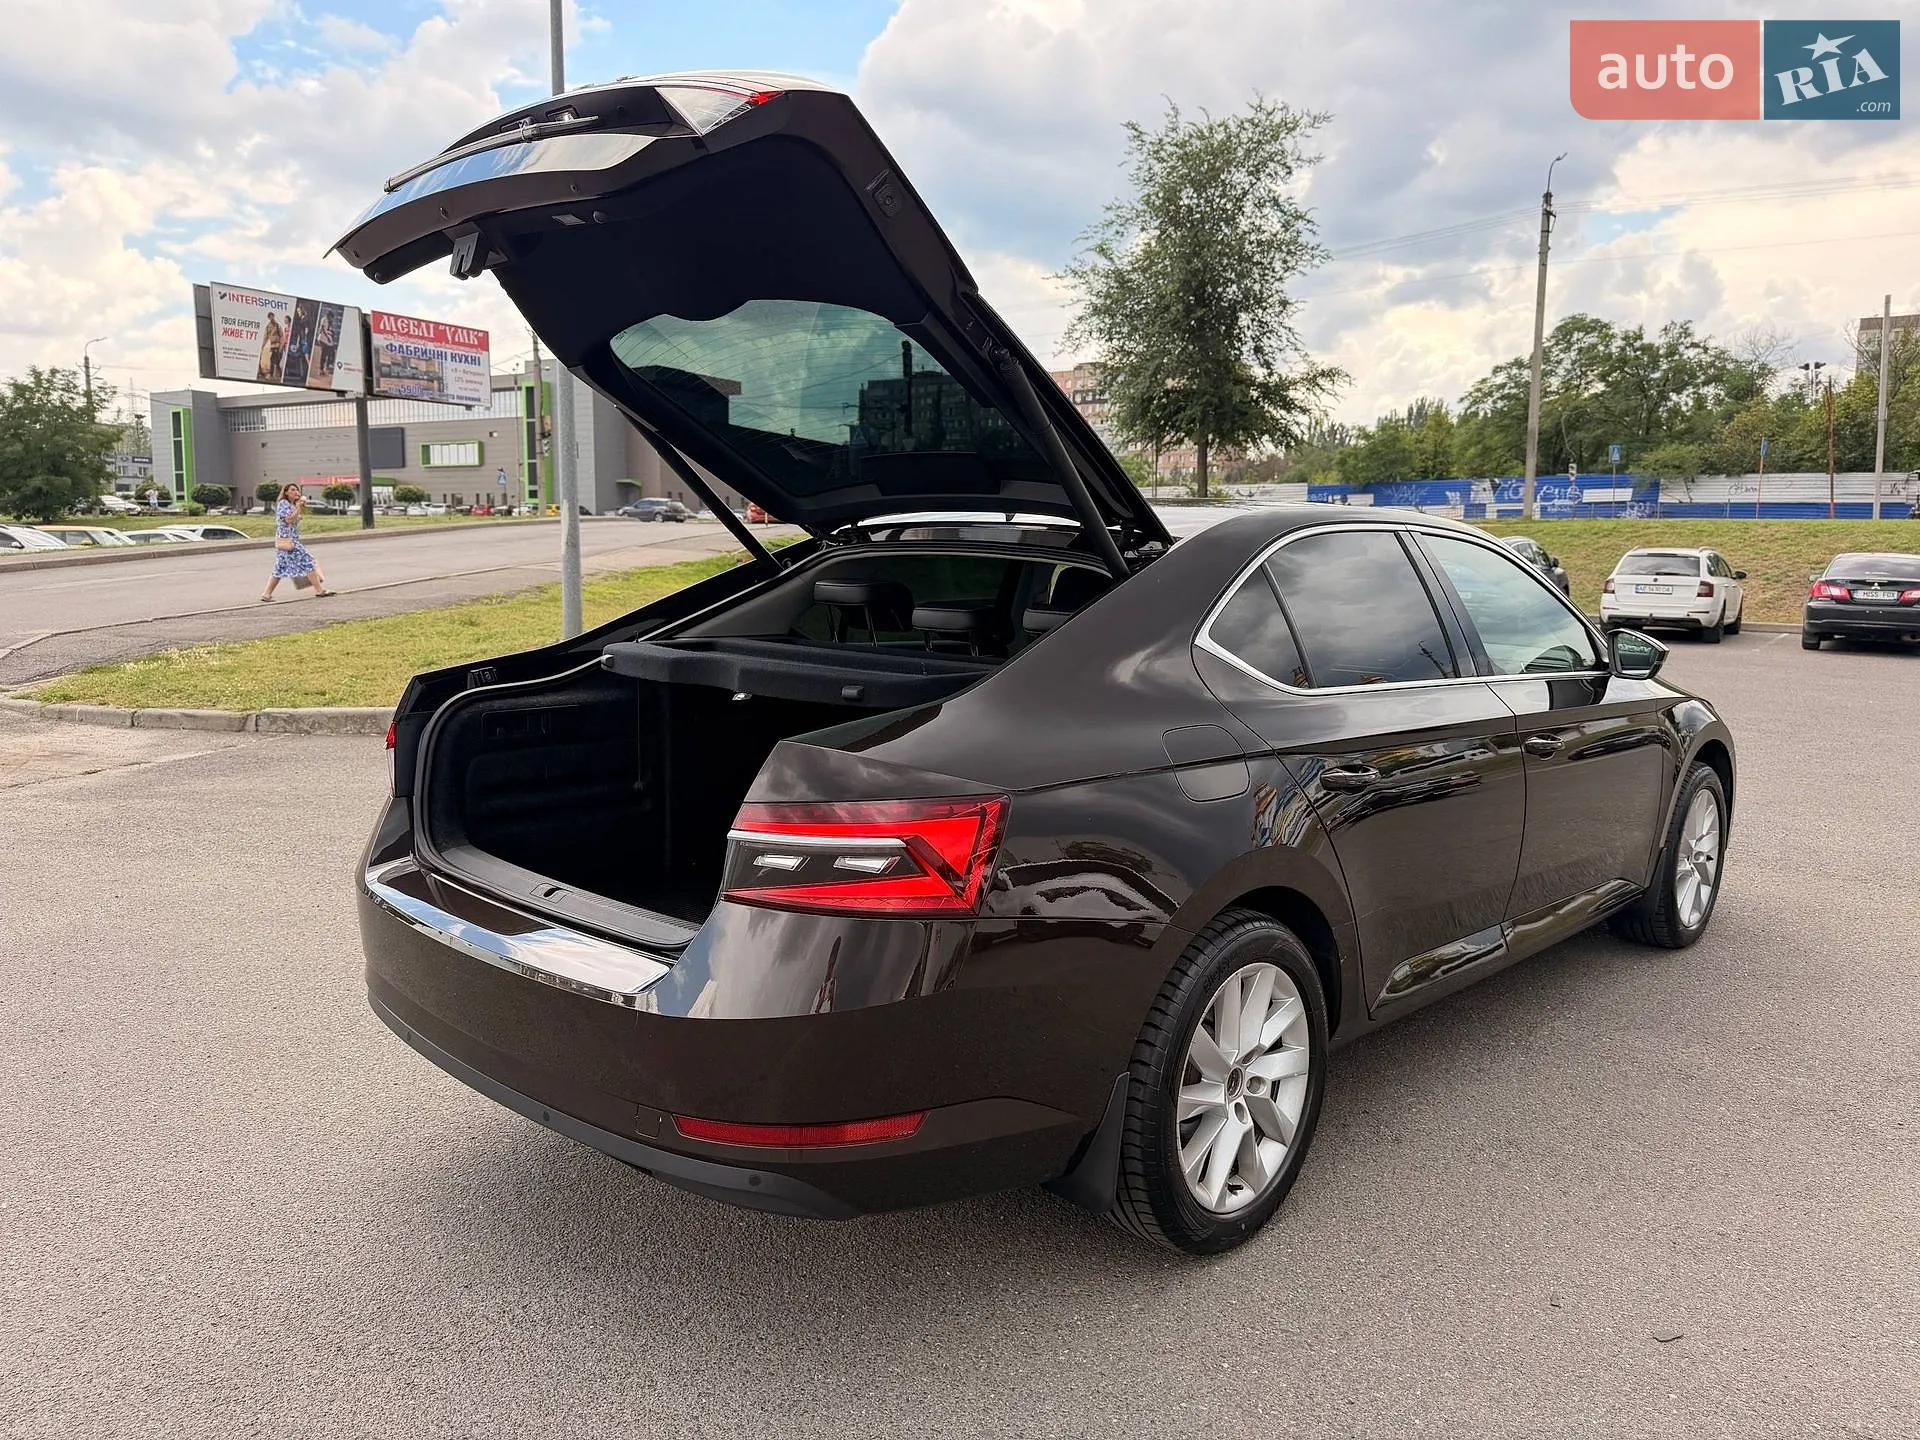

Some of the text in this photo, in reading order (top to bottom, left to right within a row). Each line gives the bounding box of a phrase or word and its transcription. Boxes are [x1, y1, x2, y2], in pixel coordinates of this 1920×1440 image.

[228, 291, 288, 311] INTERSPORT
[221, 316, 236, 325] ТВОЯ
[221, 327, 259, 341] ЖИВЕ ТУТ
[385, 342, 448, 362] ФАБРИЧНІ
[450, 352, 481, 367] КУХНІ
